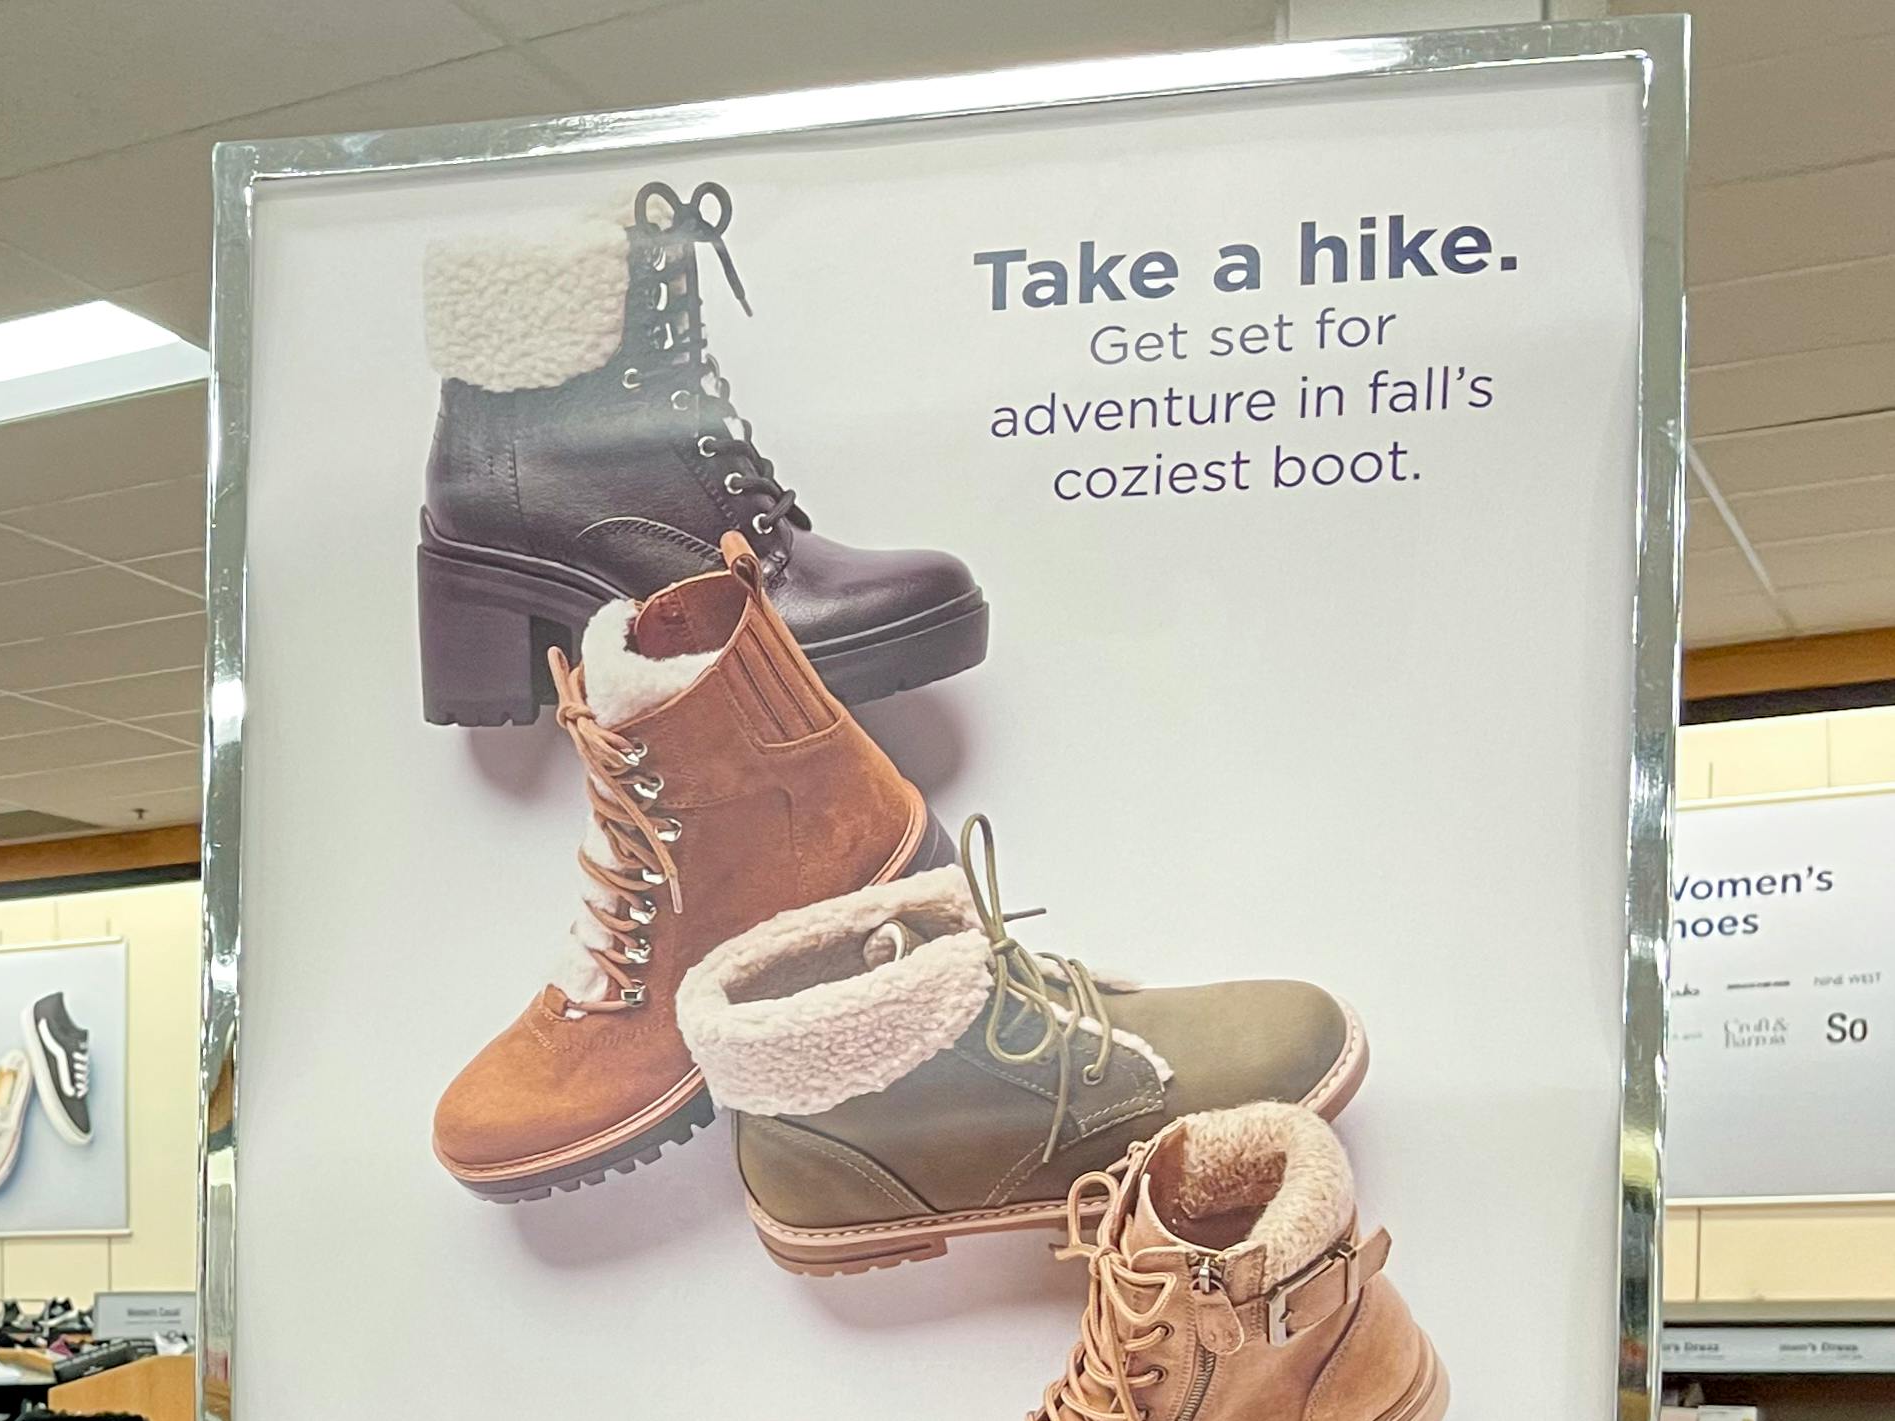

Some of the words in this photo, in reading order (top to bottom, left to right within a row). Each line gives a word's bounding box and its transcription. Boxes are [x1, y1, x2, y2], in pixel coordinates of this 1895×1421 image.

[973, 240, 1179, 312] Take
[1212, 242, 1261, 293] a
[1299, 213, 1518, 286] hike.
[1090, 321, 1188, 366] Get
[1209, 313, 1294, 357] set
[1315, 307, 1397, 349] for
[990, 386, 1276, 439] adventure
[1299, 375, 1345, 418] in
[1368, 366, 1495, 414] fall's
[1053, 450, 1252, 501] coziest
[1273, 441, 1422, 488] boot.
[1826, 1011, 1869, 1044] So
